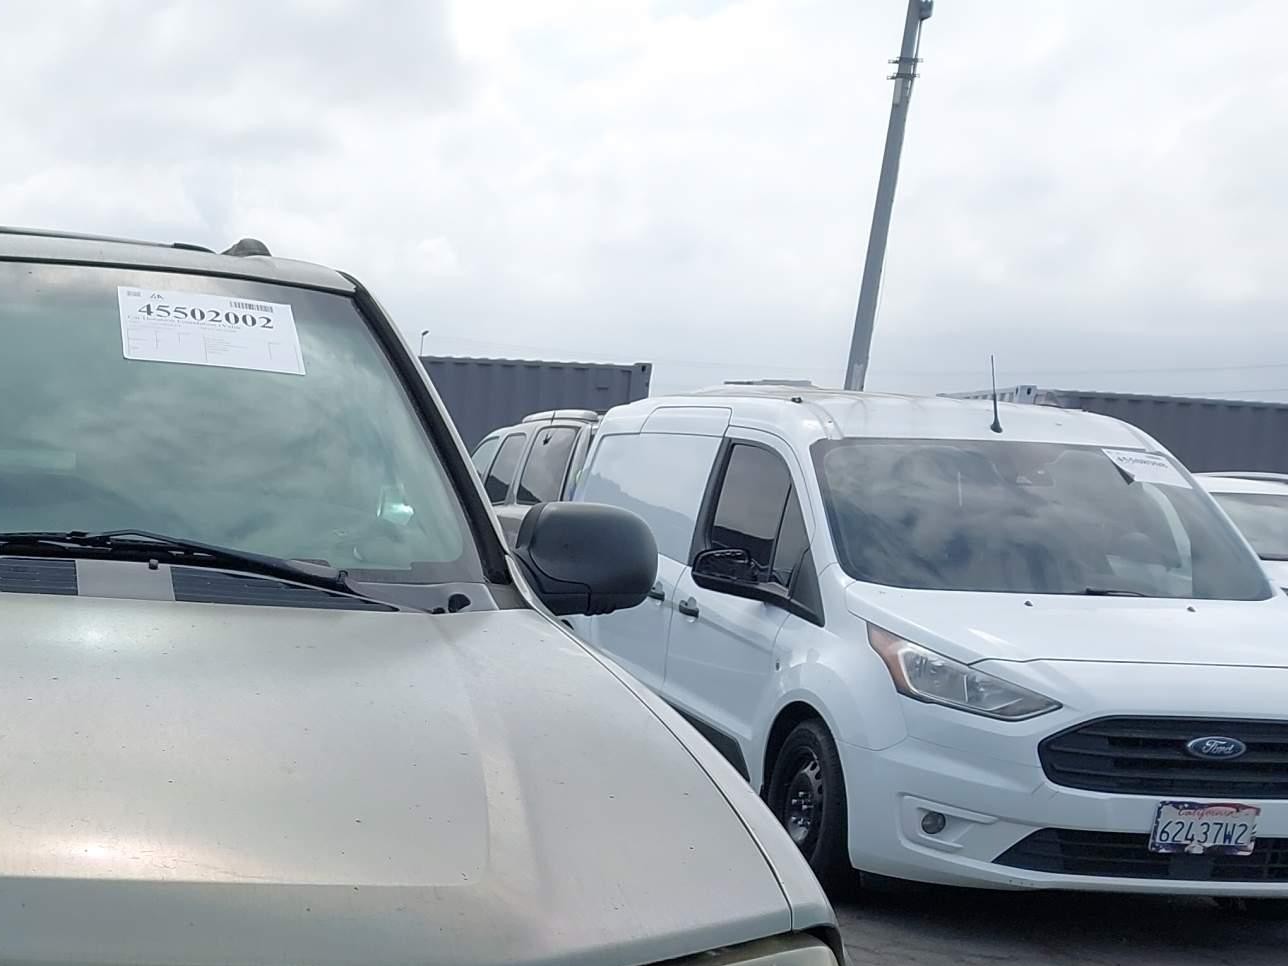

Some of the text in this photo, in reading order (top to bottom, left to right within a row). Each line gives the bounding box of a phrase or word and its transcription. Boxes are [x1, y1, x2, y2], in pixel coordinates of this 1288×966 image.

[138, 303, 274, 329] 45502002
[1202, 740, 1234, 754] Ford
[1159, 821, 1248, 845] 62437W2
